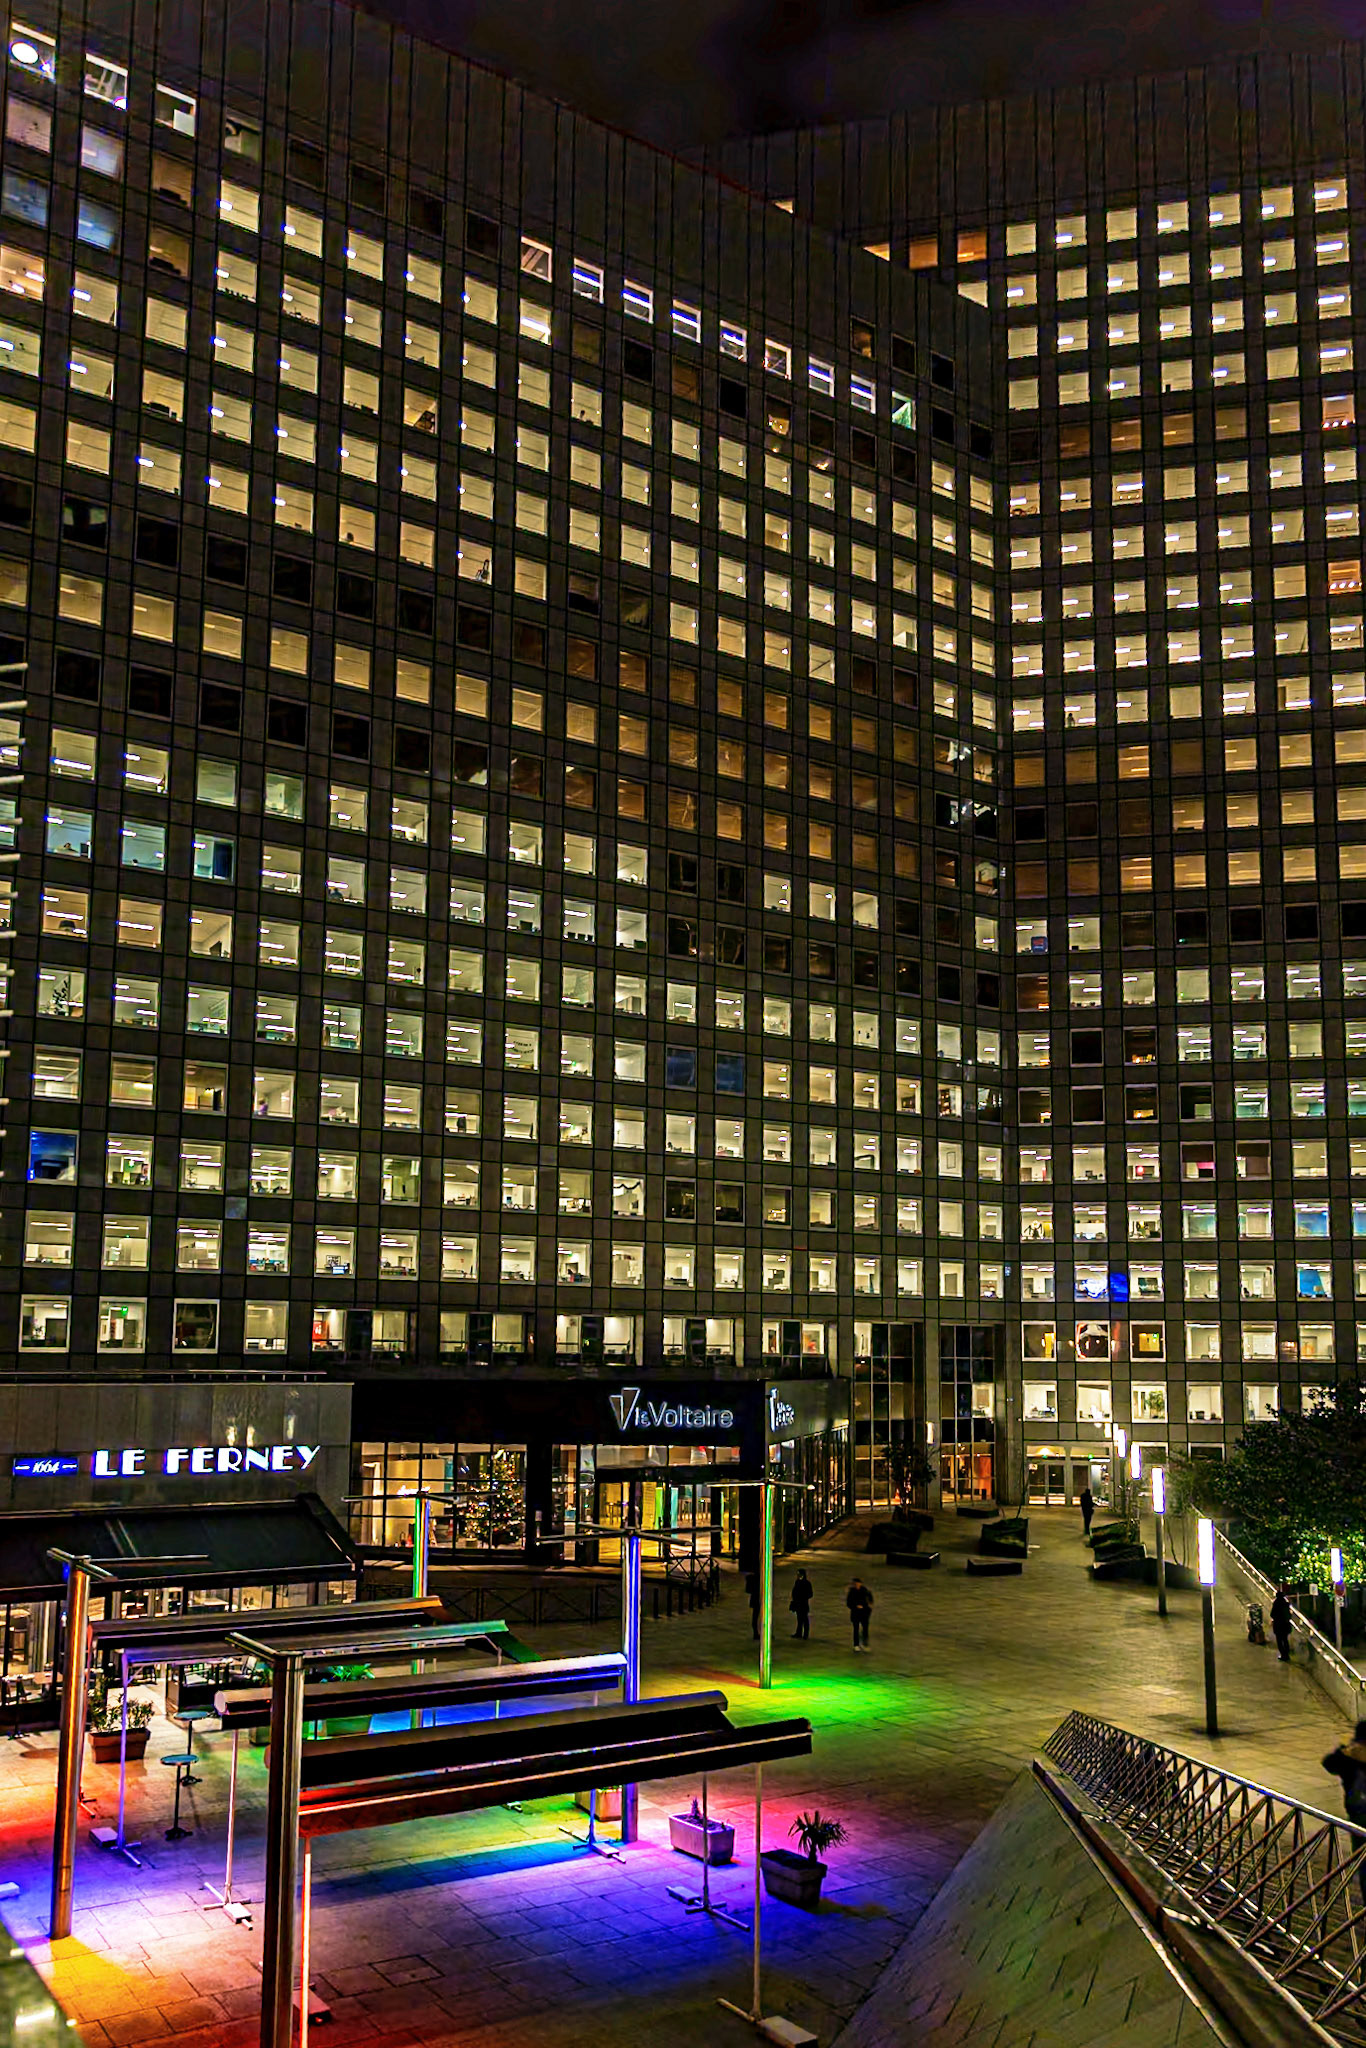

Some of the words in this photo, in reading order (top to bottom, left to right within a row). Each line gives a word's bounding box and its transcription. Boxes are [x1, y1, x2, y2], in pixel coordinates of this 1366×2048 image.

[32, 1460, 60, 1474] 1664
[94, 1448, 146, 1476] LE
[166, 1445, 321, 1475] FERNEY
